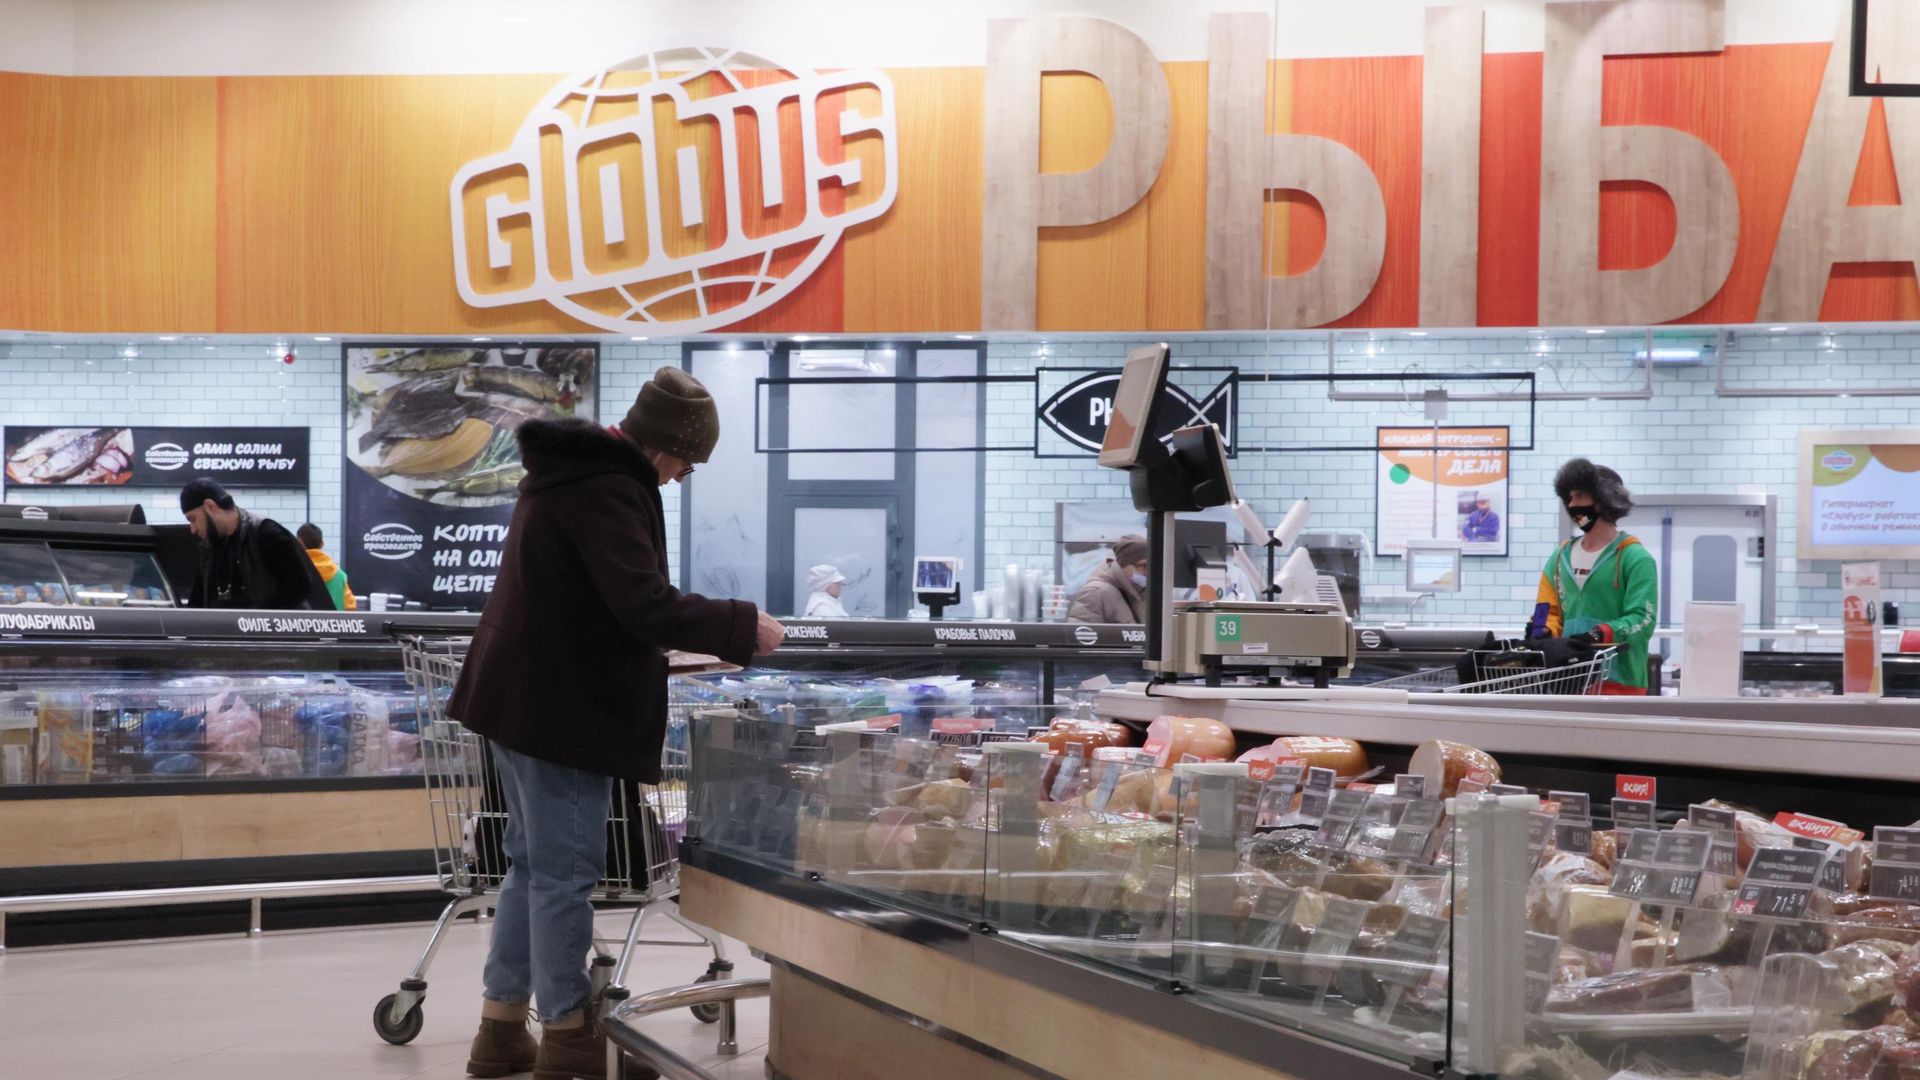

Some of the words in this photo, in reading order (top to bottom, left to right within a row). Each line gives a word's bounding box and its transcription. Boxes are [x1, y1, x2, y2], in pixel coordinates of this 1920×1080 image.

[193, 442, 232, 455] САМИ
[235, 443, 282, 455] СОЛИМ
[193, 458, 254, 470] СВЕЖУЮ
[258, 458, 296, 470] РЫБУ
[1446, 459, 1502, 476] ДЕЛА
[363, 532, 423, 542] Собственное
[433, 549, 462, 567] НА
[238, 616, 272, 633] ФИЛЕ
[274, 618, 367, 634] ЗАМОРОЖЕННОЕ
[1219, 621, 1237, 636] 39
[935, 628, 978, 640] КРАБОВЫЕ
[979, 628, 1016, 641] ПАЛОЧКИ
